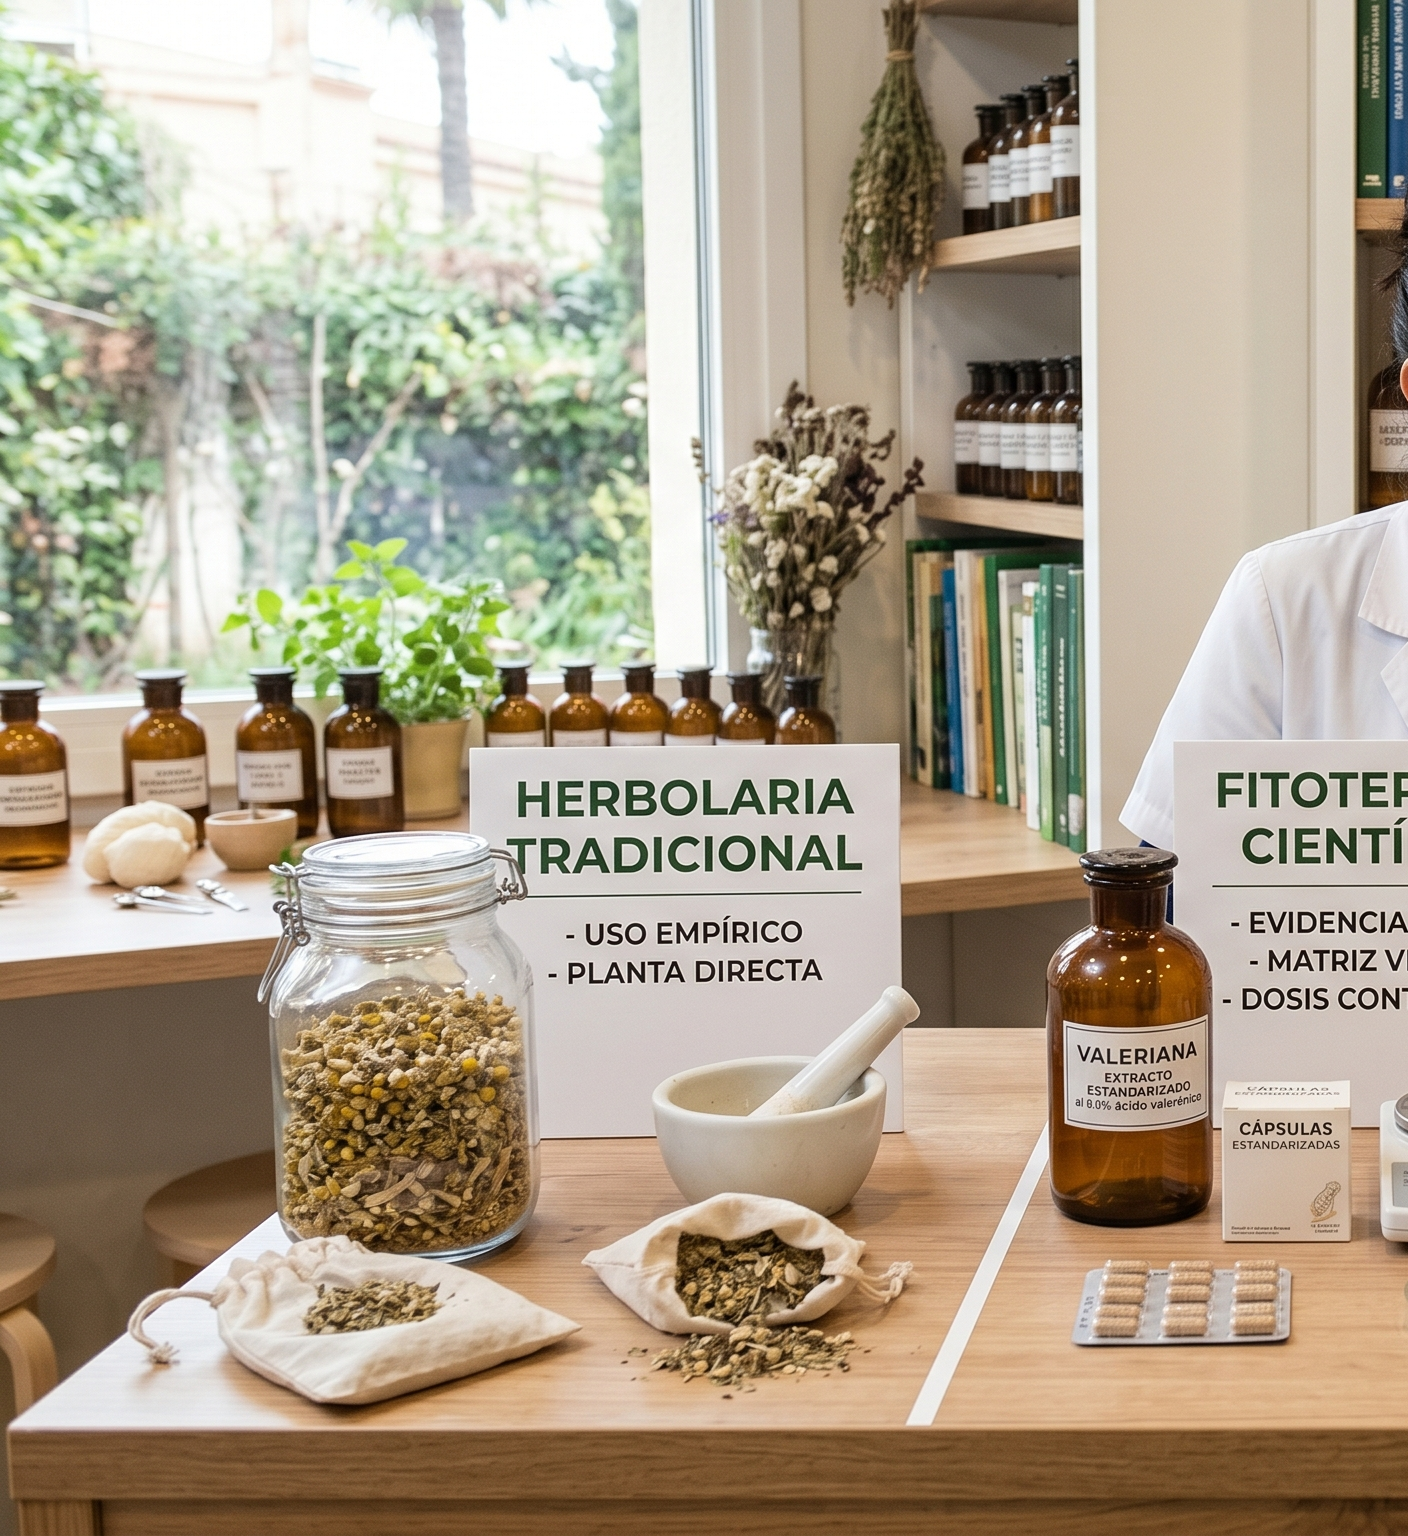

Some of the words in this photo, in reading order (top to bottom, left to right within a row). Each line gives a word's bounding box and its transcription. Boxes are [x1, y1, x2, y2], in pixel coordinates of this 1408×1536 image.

[518, 779, 854, 817] HERBOLARIA
[507, 834, 862, 874] TRADICIONAL
[586, 923, 646, 945] USO
[658, 916, 802, 944] EMPÍRICO
[1251, 911, 1408, 933] EVIDENCIA
[569, 961, 685, 984] PLANTA
[696, 959, 822, 982] DIRECTA
[1269, 950, 1377, 971] MATRIZ
[1243, 988, 1329, 1010] DOSIS
[1077, 1041, 1197, 1065] VALERIANA
[1105, 1070, 1172, 1083] EXTRACTO
[1087, 1081, 1190, 1097] ESTANDARIZADO
[1075, 1098, 1083, 1107] al
[1240, 1119, 1332, 1135] CÁPSULAS
[1233, 1140, 1340, 1149] ESTANDARIZADAS
